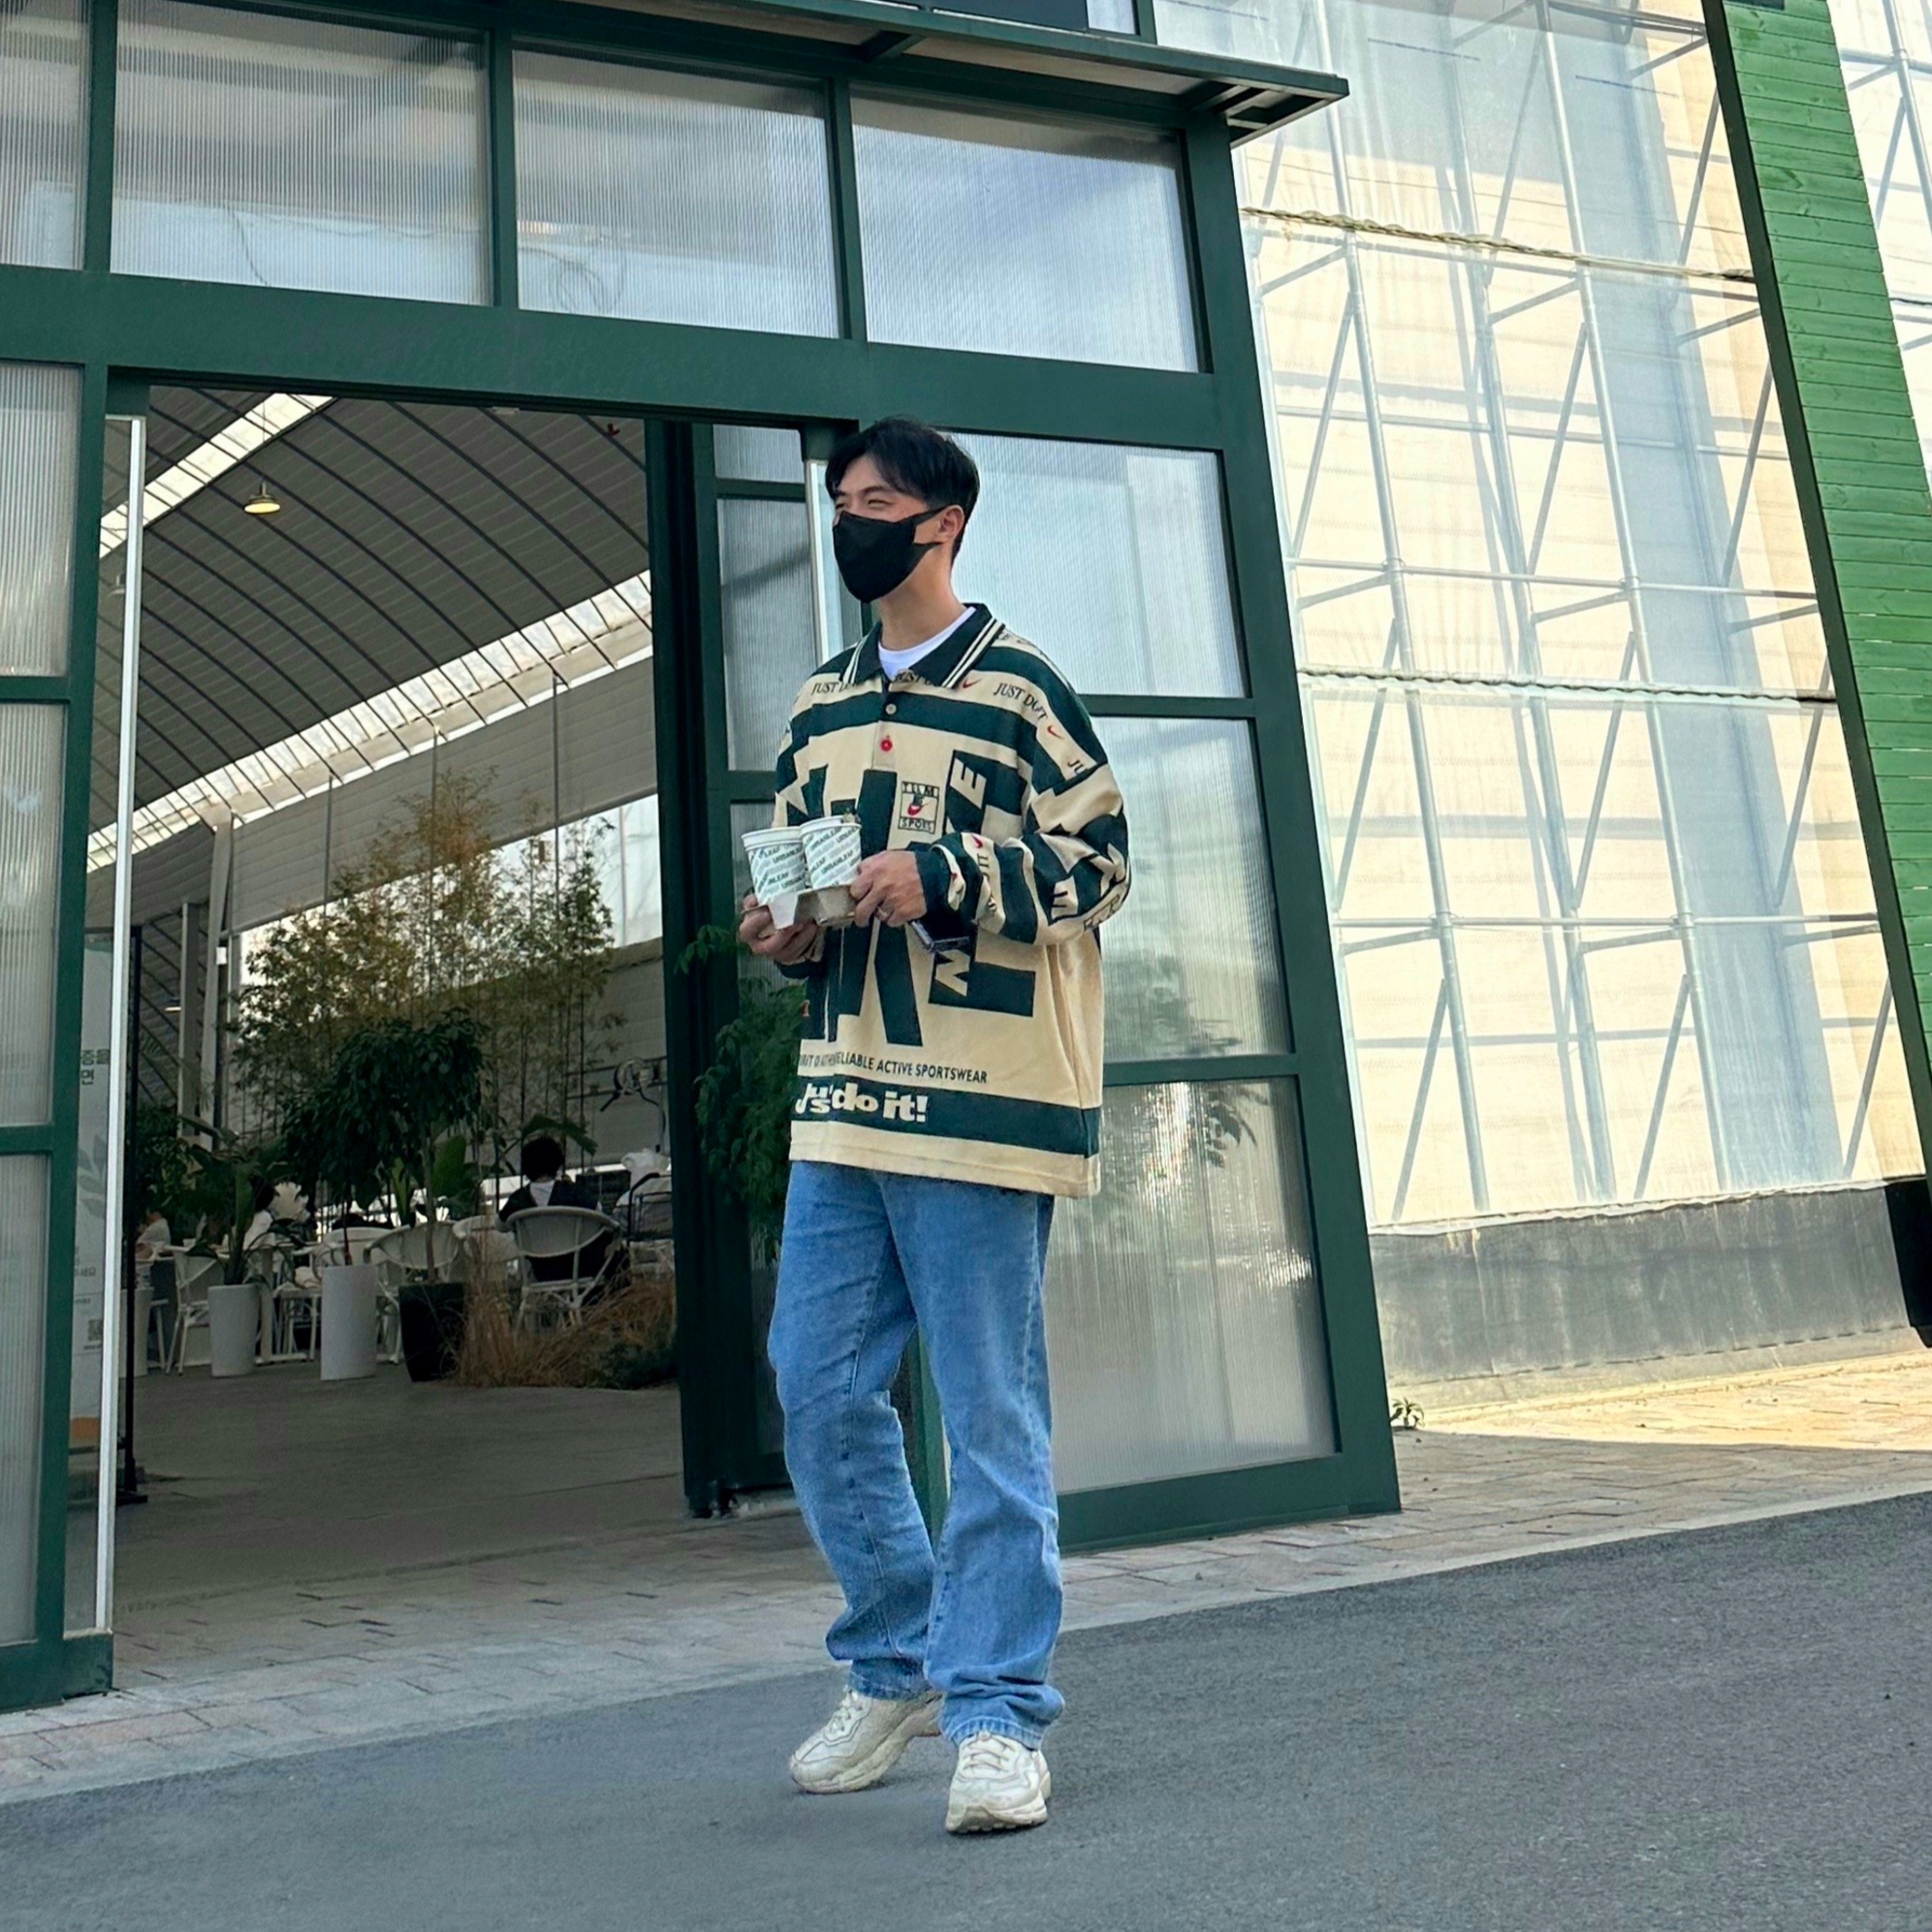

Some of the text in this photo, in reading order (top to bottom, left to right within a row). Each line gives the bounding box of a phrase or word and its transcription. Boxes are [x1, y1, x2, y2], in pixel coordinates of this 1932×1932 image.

[811, 681, 839, 695] JUST
[993, 681, 1026, 700] JUST
[876, 1059, 913, 1076] ACTIVE
[914, 1063, 988, 1085] SPORTSWEAR
[832, 1082, 878, 1113] do
[882, 1091, 928, 1123] it!
